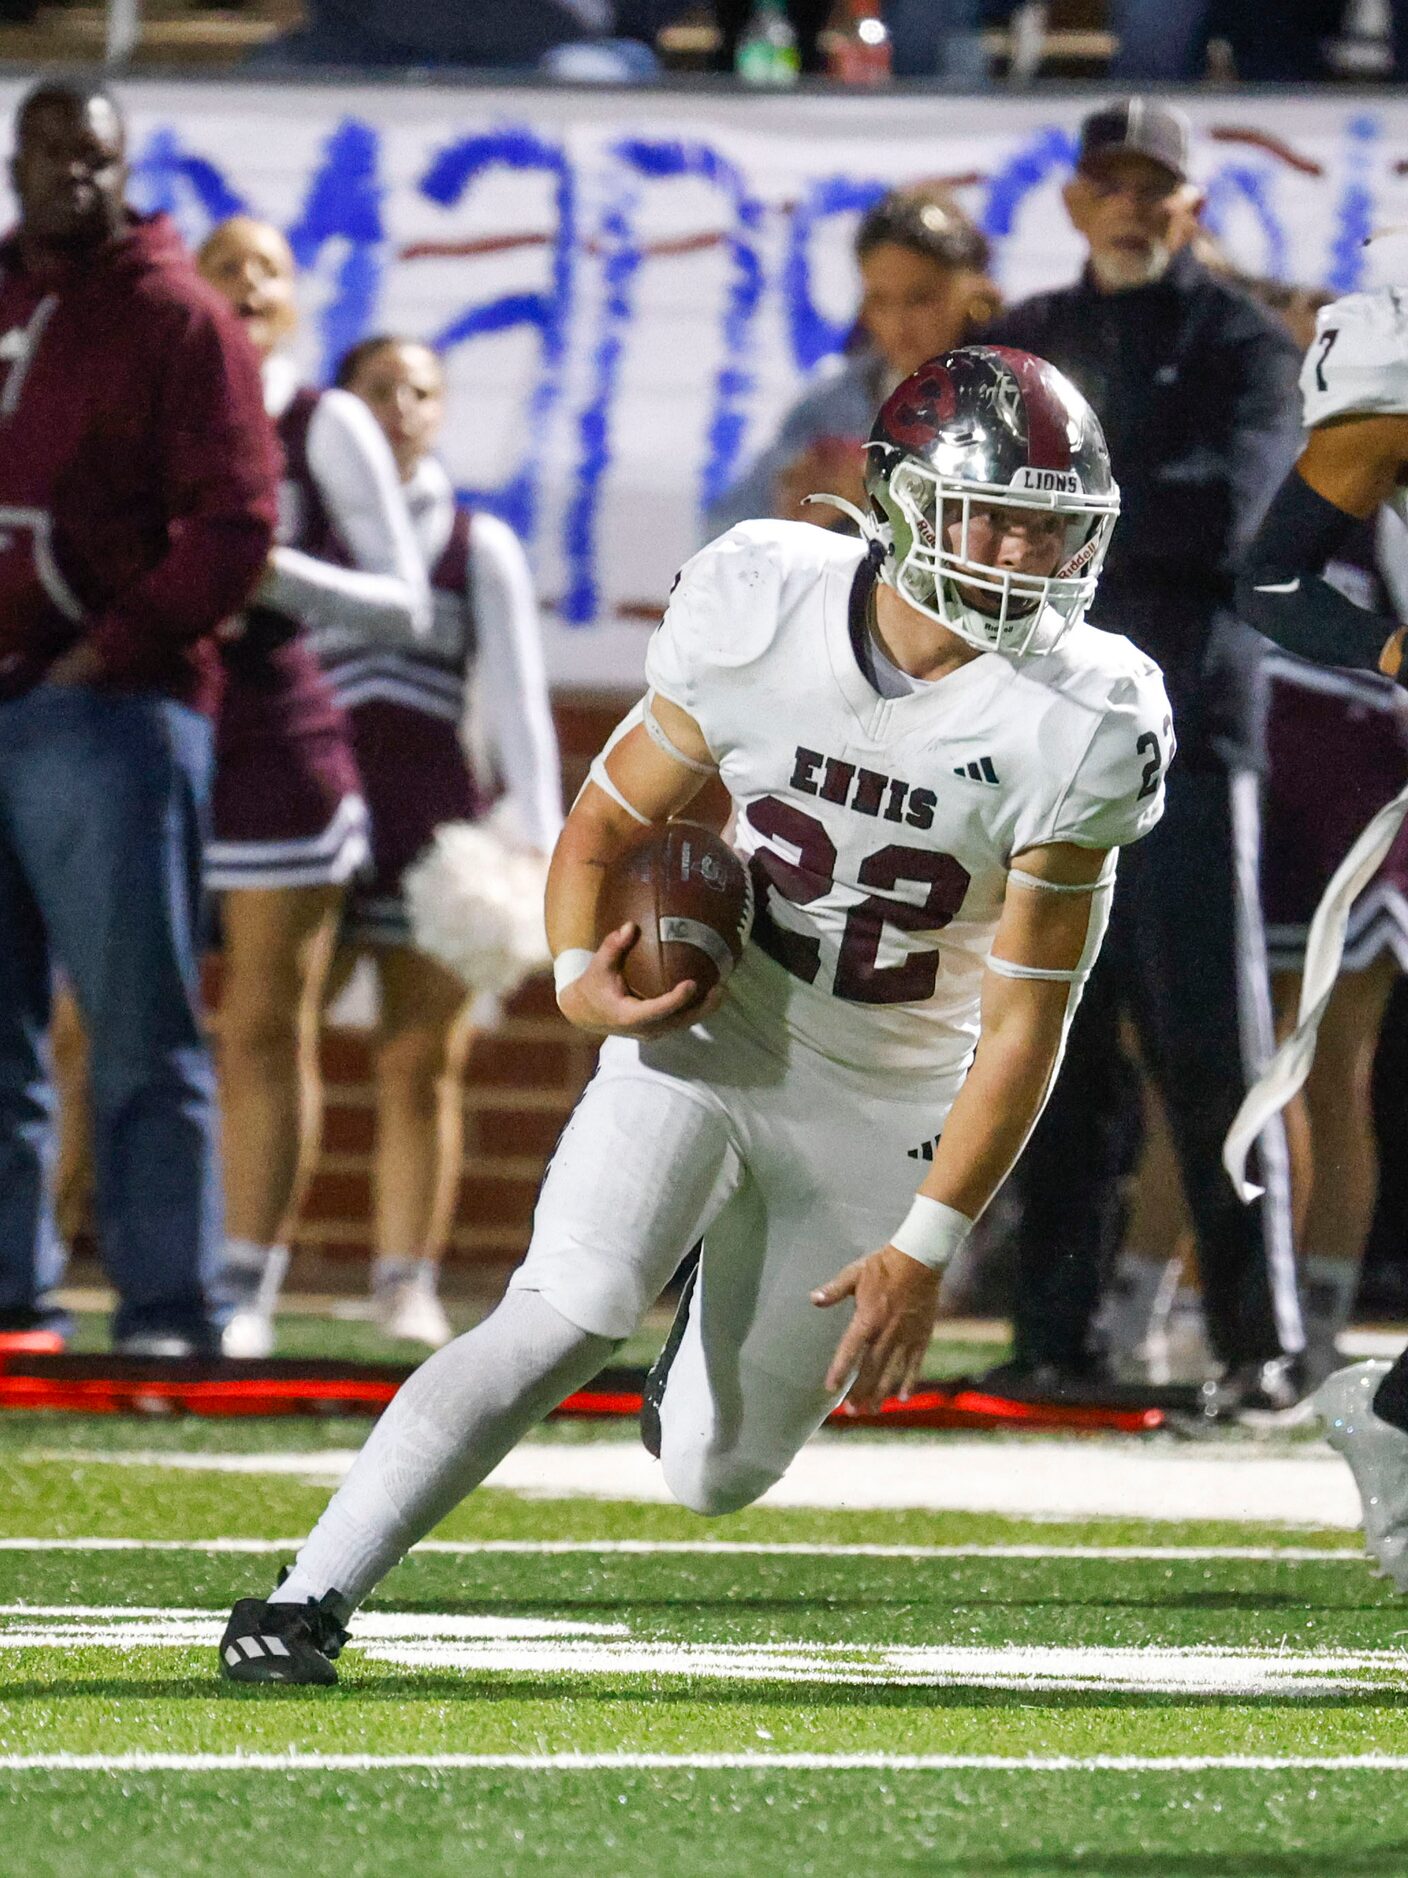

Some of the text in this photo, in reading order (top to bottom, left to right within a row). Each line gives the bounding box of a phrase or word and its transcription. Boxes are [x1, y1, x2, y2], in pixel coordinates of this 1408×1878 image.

[1316, 328, 1340, 392] 7
[1024, 471, 1077, 493] LIONS
[1057, 541, 1096, 579] Riddell
[789, 745, 938, 829] ENNIS
[746, 795, 972, 1004] 22
